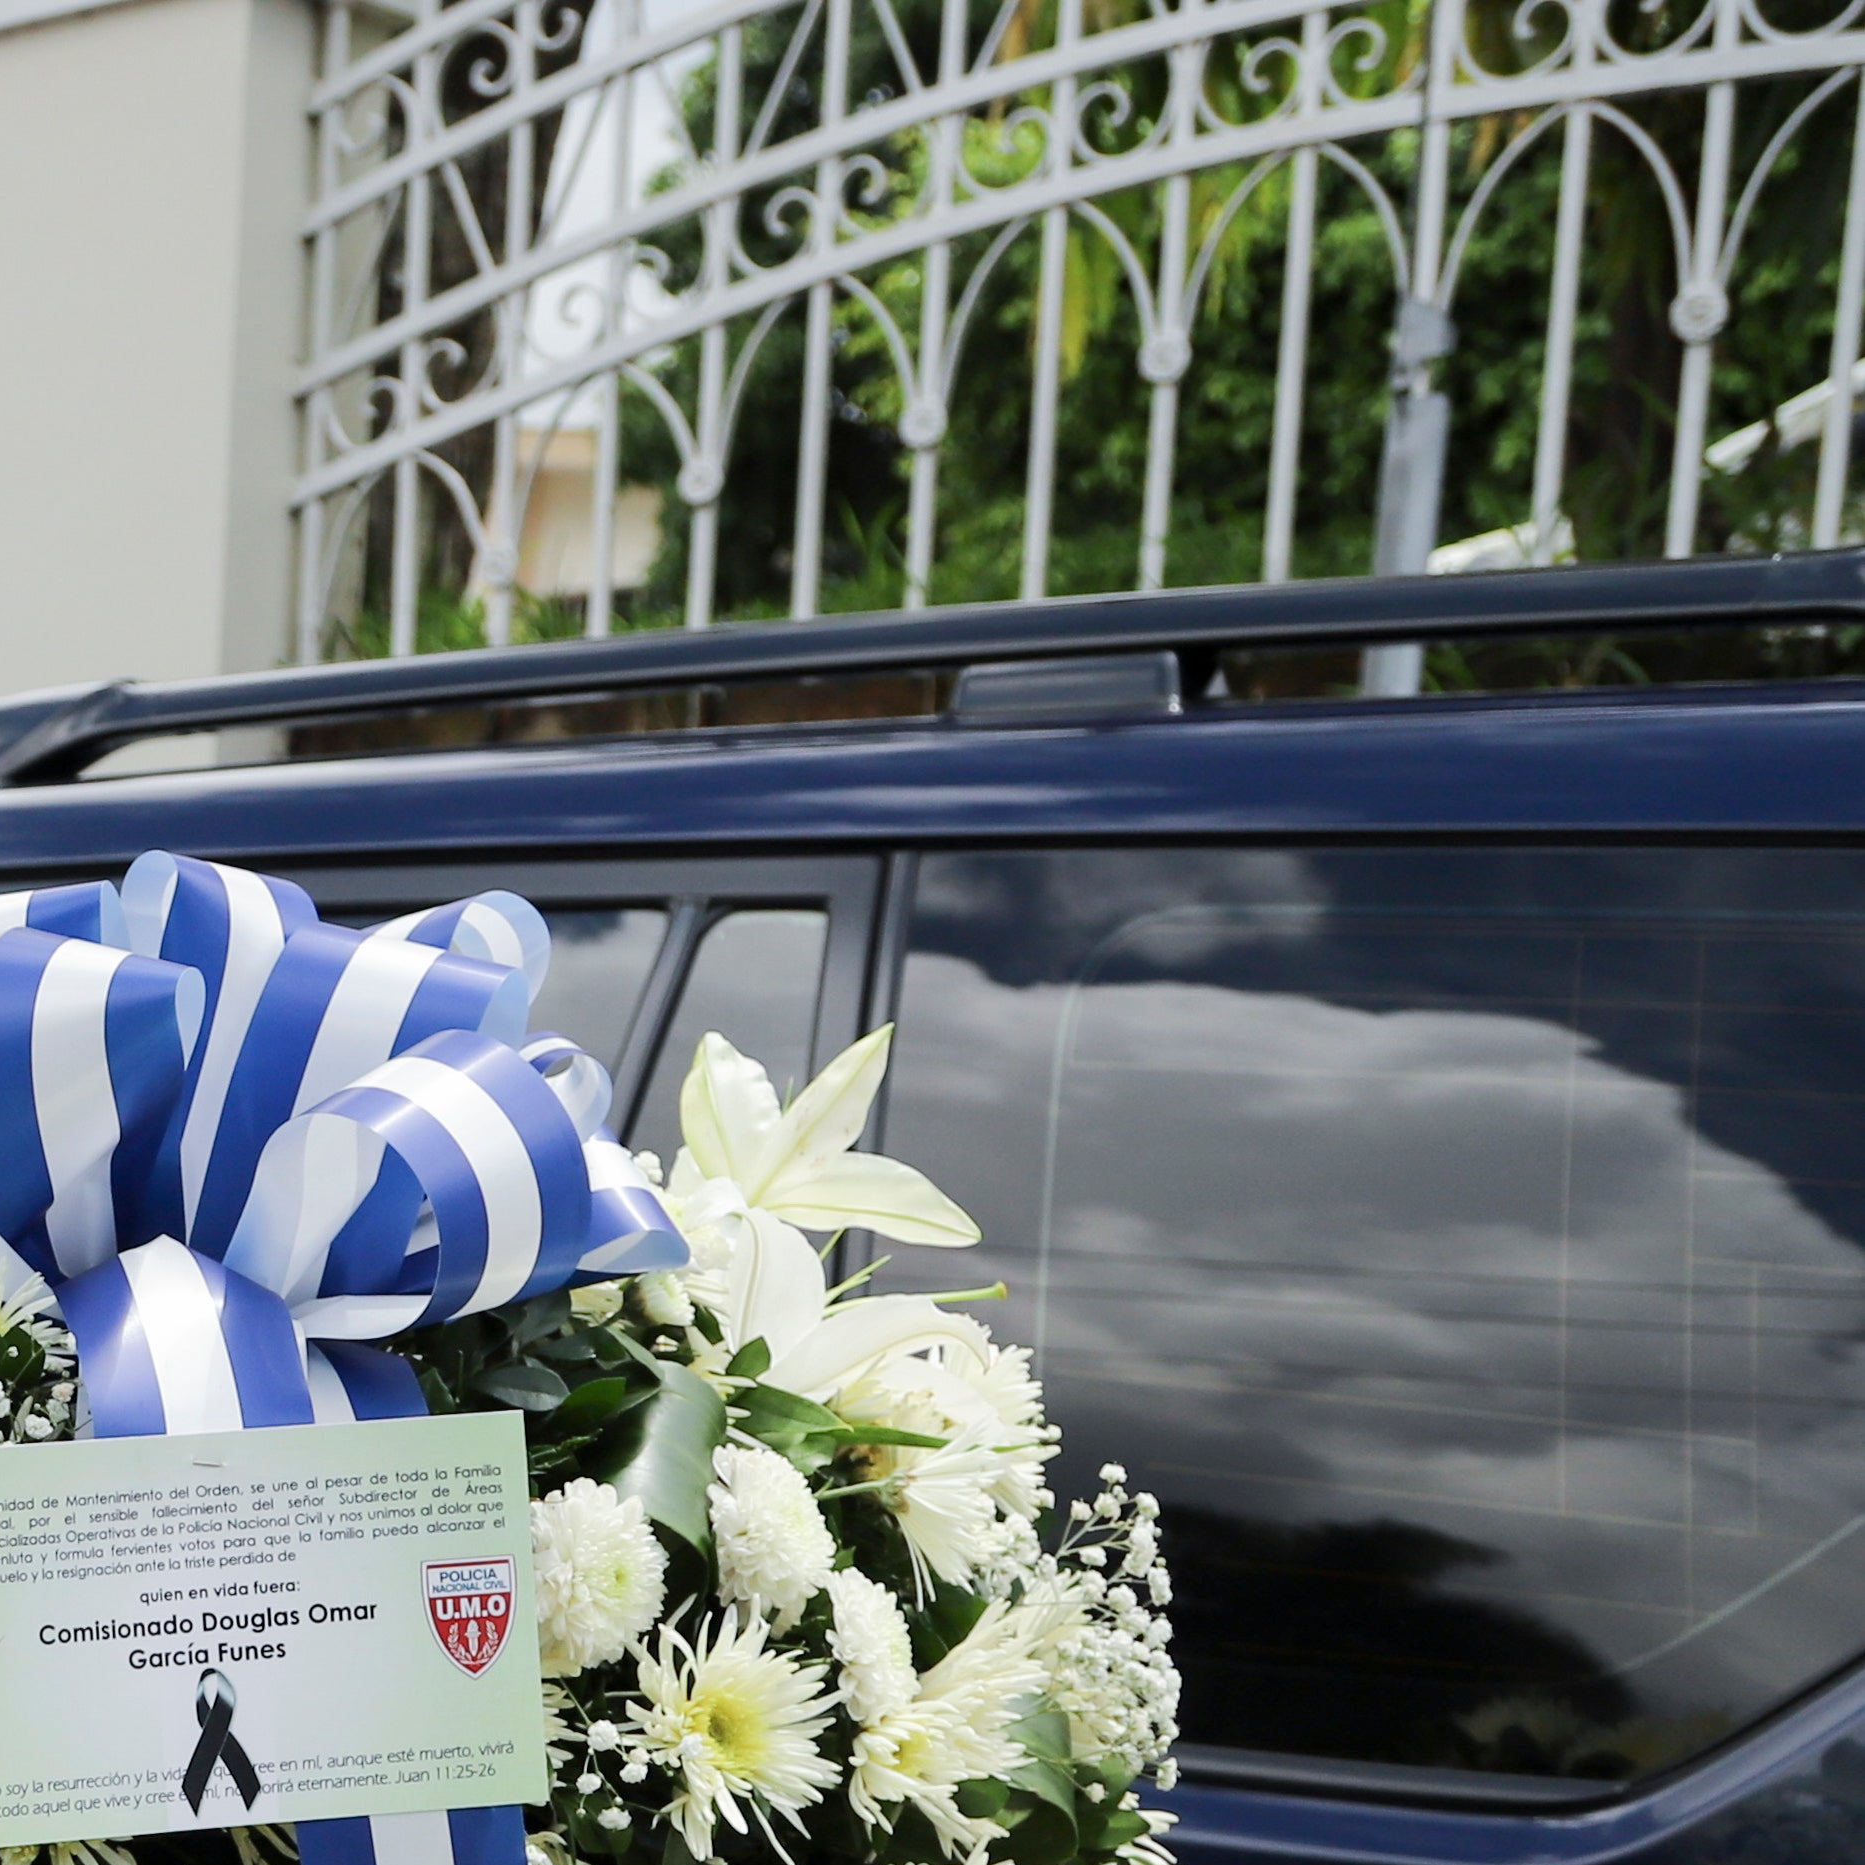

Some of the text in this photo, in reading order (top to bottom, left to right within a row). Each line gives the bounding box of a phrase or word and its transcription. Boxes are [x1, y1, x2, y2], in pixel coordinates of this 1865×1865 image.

[28, 1516, 52, 1530] por
[64, 1512, 77, 1525] el
[88, 1508, 139, 1524] sensible
[151, 1502, 238, 1519] fallecimiento
[251, 1497, 274, 1511] del
[287, 1492, 325, 1509] señor
[338, 1488, 418, 1505] Subdirector
[431, 1485, 451, 1498] de
[464, 1480, 503, 1496] Áreas
[41, 1496, 59, 1509] de
[65, 1489, 164, 1507] Mantenimiento
[169, 1486, 190, 1499] del
[195, 1484, 244, 1498] Orden,
[250, 1484, 266, 1494] se
[272, 1481, 299, 1492] une
[305, 1476, 319, 1490] al
[324, 1476, 364, 1492] pesar
[369, 1473, 389, 1485] de
[395, 1469, 429, 1483] toda
[434, 1468, 448, 1480] la
[454, 1464, 502, 1479] Familia
[40, 1552, 48, 1566] y
[55, 1547, 104, 1562] formula
[110, 1542, 173, 1558] fervientes
[179, 1540, 216, 1552] votos
[223, 1537, 257, 1551] para
[264, 1535, 292, 1548] que
[298, 1531, 312, 1543] la
[319, 1526, 365, 1541] familia
[372, 1523, 419, 1540] pueda
[426, 1517, 487, 1534] alcanzar
[492, 1516, 506, 1529] el
[65, 1527, 137, 1544] Operativas
[140, 1525, 158, 1537] de
[162, 1523, 175, 1536] la
[178, 1520, 223, 1535] Policía
[227, 1515, 291, 1531] Nacional
[294, 1511, 323, 1526] Civil
[326, 1512, 336, 1525] y
[339, 1511, 364, 1522] nos
[367, 1507, 416, 1520] unimos
[420, 1504, 434, 1517] al
[437, 1502, 473, 1516] dolor
[476, 1500, 504, 1515] que
[30, 1571, 39, 1584] y
[41, 1568, 55, 1581] la
[56, 1562, 132, 1580] resignación
[134, 1558, 166, 1573] ante
[168, 1557, 181, 1570] la
[184, 1556, 216, 1569] triste
[218, 1552, 274, 1569] perdida
[277, 1550, 297, 1562] de
[439, 1568, 498, 1583] POLICIA
[138, 1579, 302, 1604] quien en vida fuera:
[435, 1594, 507, 1621] U.M.O
[38, 1603, 379, 1646] Comisionado Douglas Omar
[128, 1641, 287, 1670] García Funes
[5, 1782, 28, 1796] soy
[32, 1780, 44, 1792] la
[48, 1772, 131, 1790] resurrección
[133, 1773, 144, 1784] y
[146, 1769, 158, 1782] la
[253, 1762, 275, 1774] ree
[279, 1759, 298, 1771] en
[326, 1752, 383, 1770] aunque
[386, 1748, 416, 1764] esté
[419, 1745, 475, 1762] muerto,
[478, 1740, 515, 1756] vivirá
[32, 1800, 71, 1817] aquel
[74, 1798, 101, 1814] que
[104, 1794, 131, 1808] vive
[133, 1796, 146, 1809] y
[145, 1791, 176, 1805] cree
[259, 1777, 294, 1794] orirá
[297, 1771, 392, 1792] eternamente.
[394, 1768, 431, 1785] Juan
[434, 1763, 497, 1781] 11:25-26
